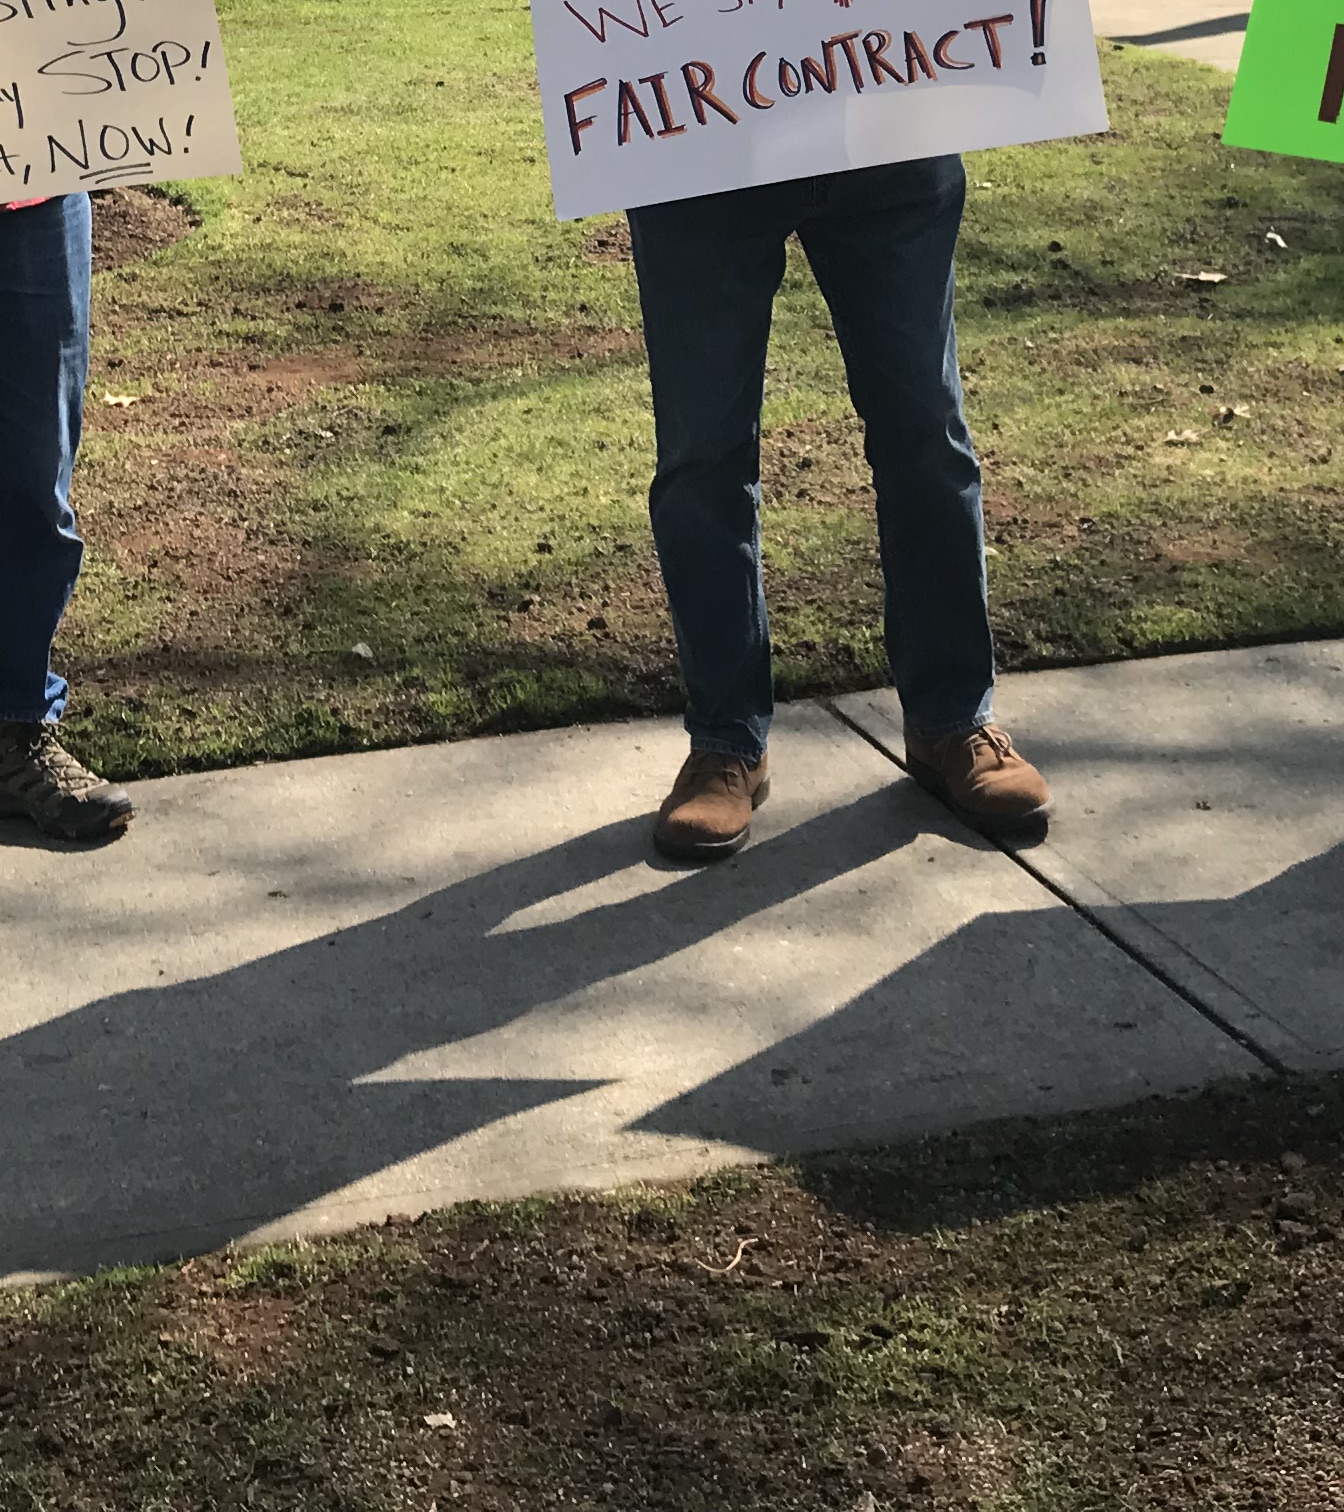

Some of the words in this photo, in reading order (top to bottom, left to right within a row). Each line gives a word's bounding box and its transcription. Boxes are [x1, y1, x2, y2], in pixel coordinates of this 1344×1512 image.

[36, 40, 212, 96] STOP!
[563, 59, 741, 157] FAIR
[48, 114, 196, 175] NOW!
